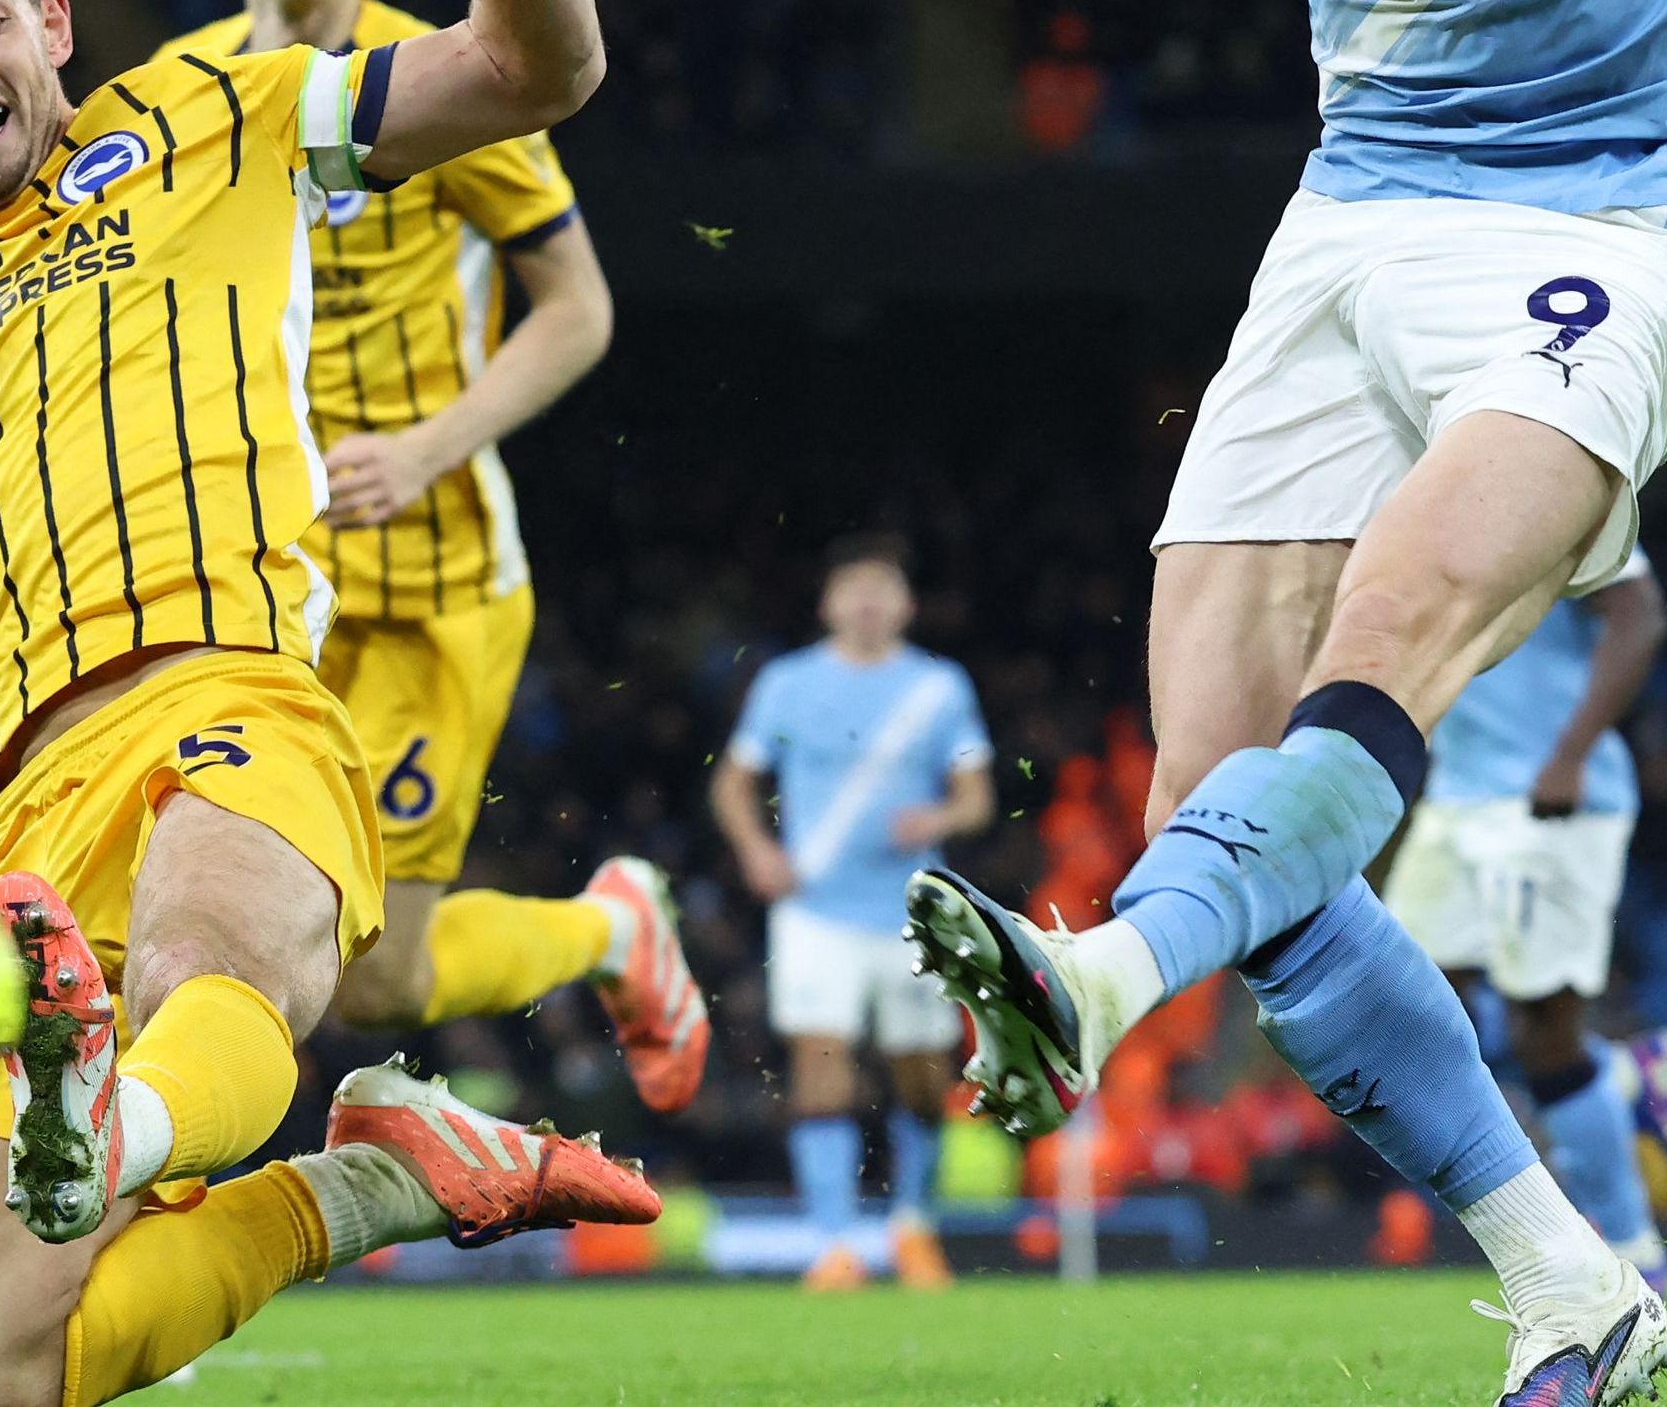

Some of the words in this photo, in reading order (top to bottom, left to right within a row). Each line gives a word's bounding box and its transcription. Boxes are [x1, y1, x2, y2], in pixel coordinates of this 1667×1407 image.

[1527, 275, 1610, 353] 9
[178, 725, 252, 777] 5
[380, 735, 434, 821] 6
